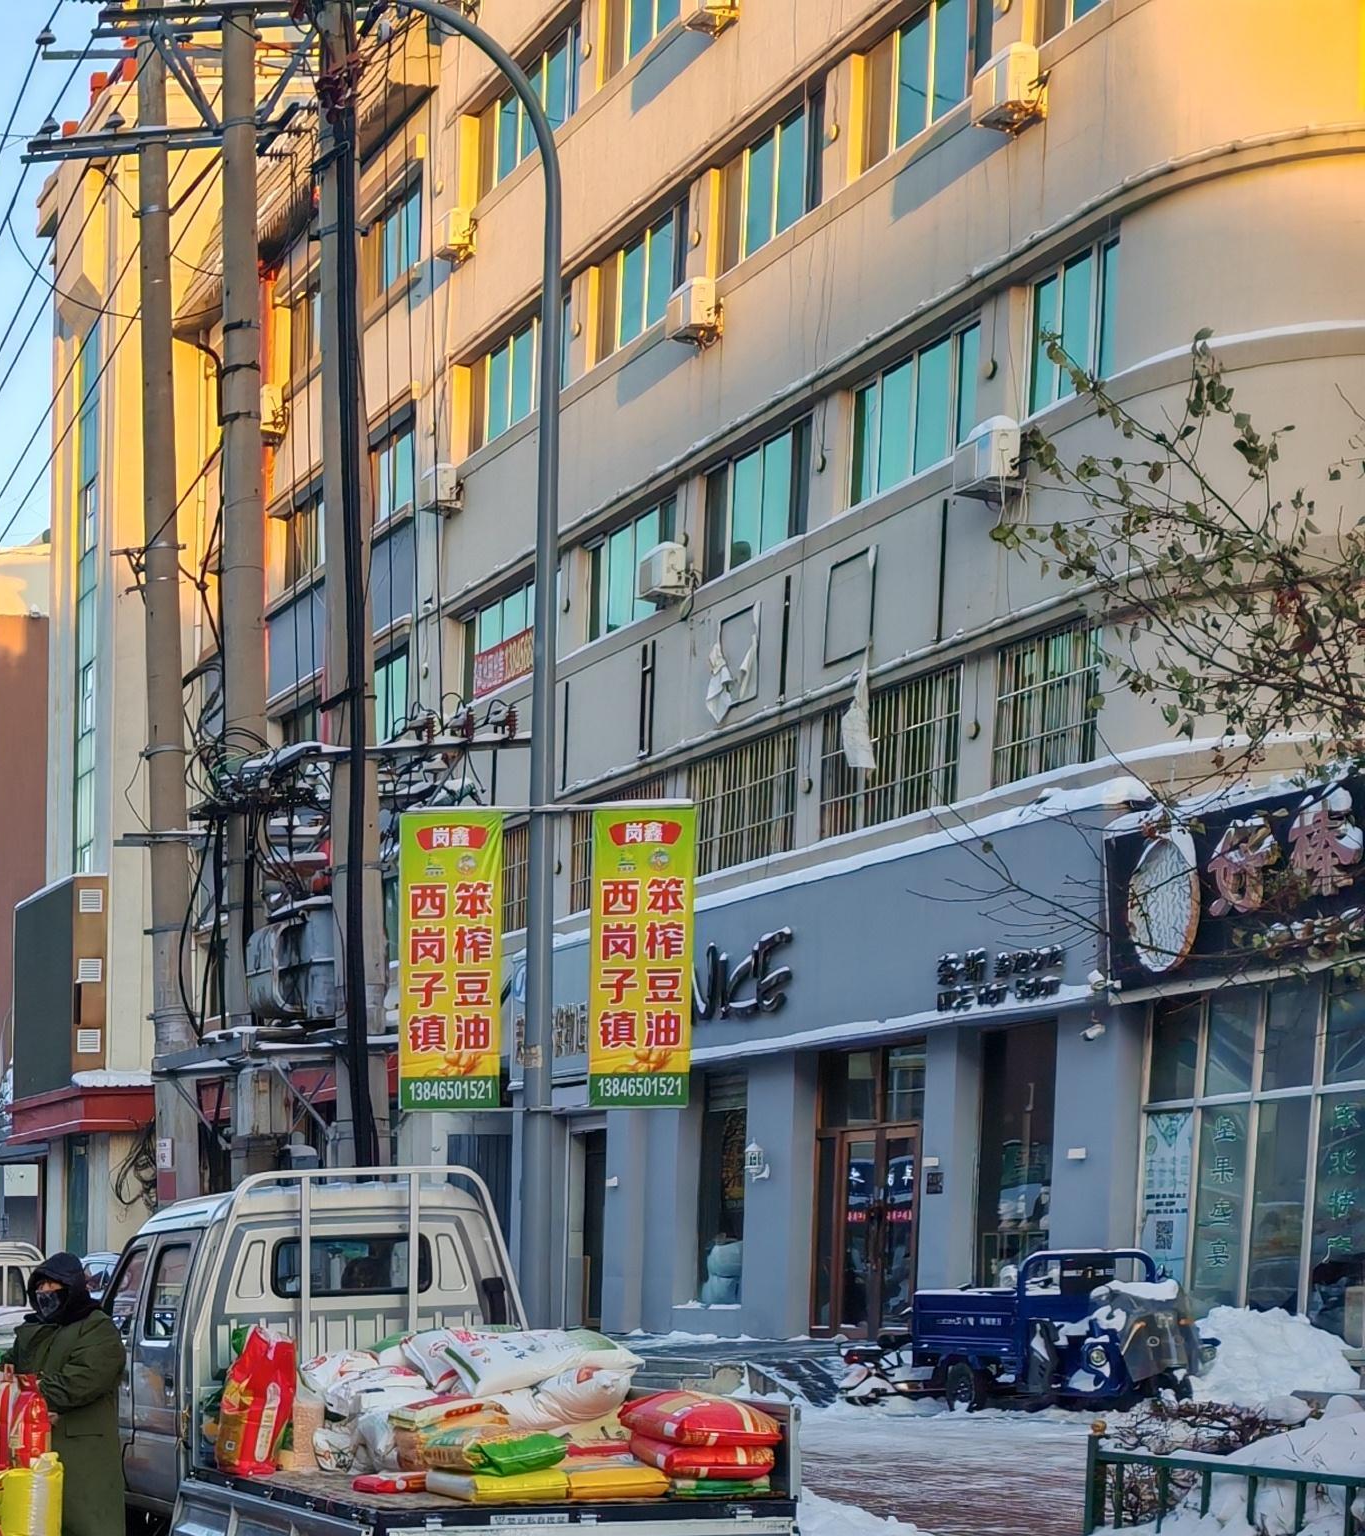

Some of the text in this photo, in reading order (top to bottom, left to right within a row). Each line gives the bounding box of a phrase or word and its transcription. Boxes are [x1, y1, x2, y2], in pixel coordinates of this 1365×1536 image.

[431, 824, 471, 849] 岗鑫
[625, 821, 663, 845] 岗鑫
[408, 882, 448, 1052] 西岗子镇
[452, 880, 492, 1052] 笨榨豆油
[599, 879, 640, 1049] 西岗子镇
[645, 877, 684, 1049] 笨榨豆油
[408, 1078, 493, 1102] 13846501521
[597, 1074, 683, 1098] 13846501521
